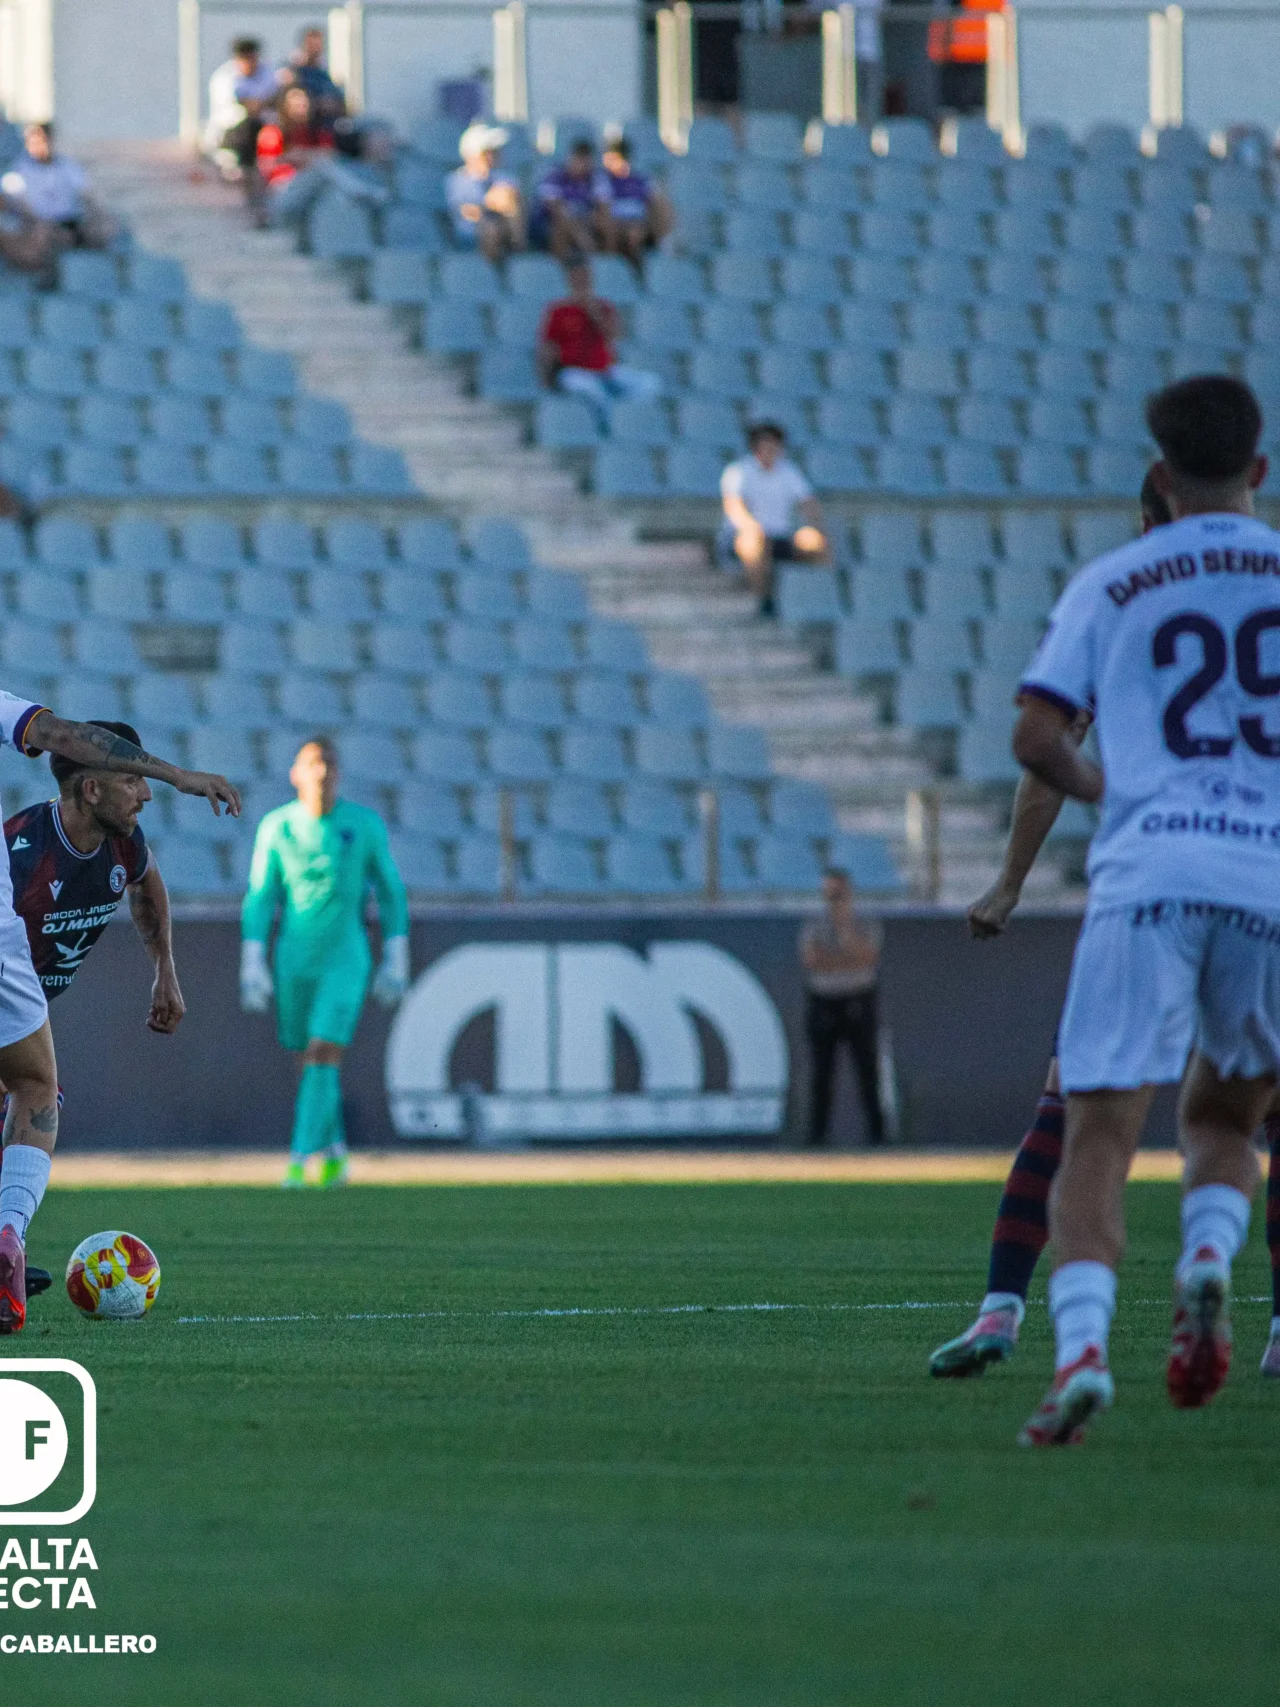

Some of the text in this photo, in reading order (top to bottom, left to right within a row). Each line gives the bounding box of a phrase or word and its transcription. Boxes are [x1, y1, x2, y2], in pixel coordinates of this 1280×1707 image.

[1103, 549, 1280, 607] DAVID SERR
[1152, 611, 1280, 759] 29
[66, 911, 115, 931] MAVE
[86, 901, 119, 915] JAECO
